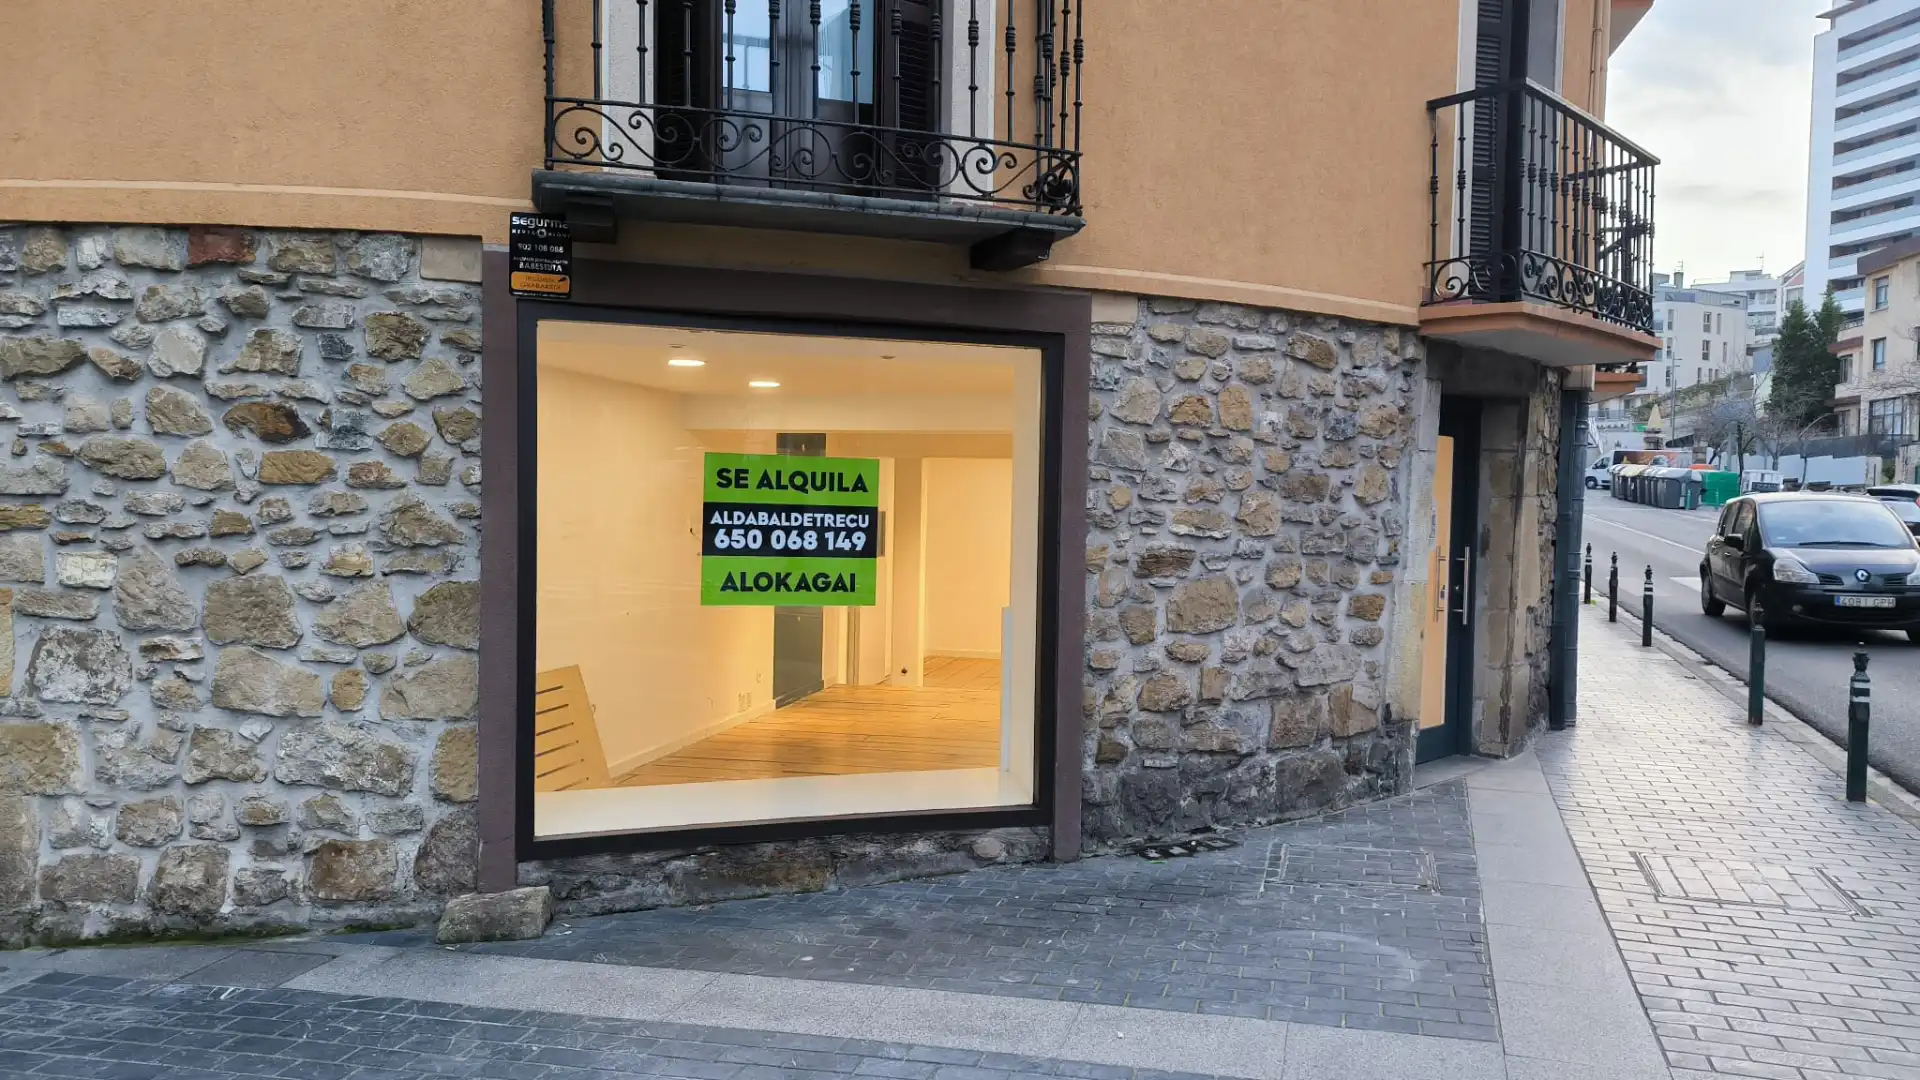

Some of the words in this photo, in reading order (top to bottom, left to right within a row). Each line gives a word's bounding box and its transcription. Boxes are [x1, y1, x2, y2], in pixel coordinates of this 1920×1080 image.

[716, 467, 749, 489] SE
[756, 469, 869, 494] ALQUILA
[710, 510, 869, 528] ALDABALDETRECU
[714, 528, 763, 549] 650
[770, 529, 818, 550] 068
[824, 531, 867, 551] 149
[720, 571, 856, 592] ALOKAGAI
